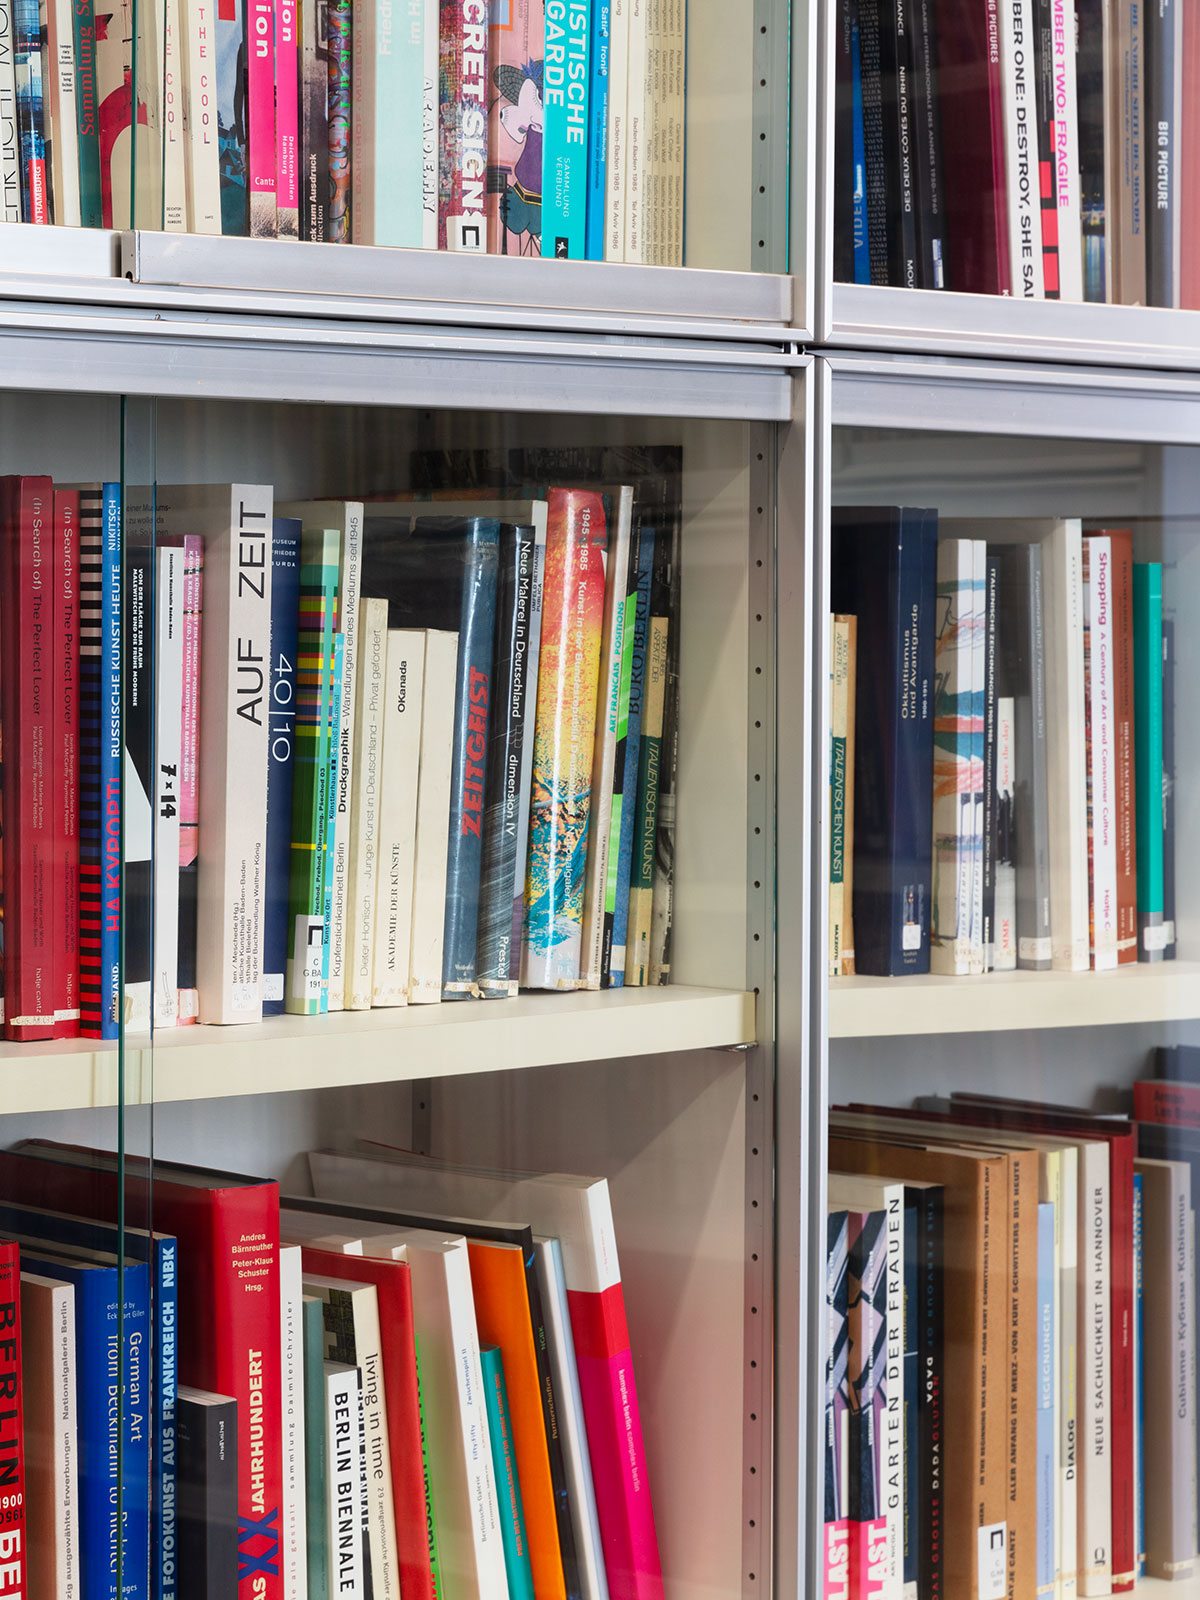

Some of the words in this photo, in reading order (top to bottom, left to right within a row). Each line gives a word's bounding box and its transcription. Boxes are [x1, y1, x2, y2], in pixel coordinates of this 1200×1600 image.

[988, 14, 999, 64] PICTURES
[78, 27, 97, 135] Sammlung
[899, 66, 907, 94] RHIN
[1014, 51, 1026, 101] ONE:
[1056, 61, 1068, 116] TWO:
[282, 135, 291, 175] Hamburg
[614, 116, 623, 170] Baden-Baden
[632, 116, 641, 170] Baden-Baden
[1015, 107, 1030, 208] DESTROY,
[1157, 121, 1170, 147] BIG
[34, 165, 44, 204] HAMBURG
[290, 135, 299, 201] Deichtorhallen
[308, 153, 318, 203] Ausdruck
[555, 156, 563, 207] VERBUND
[562, 157, 571, 218] SAMMLUNG
[614, 172, 622, 191] 1985
[632, 172, 640, 191] 1985
[903, 156, 911, 188] DEUX
[1058, 121, 1070, 208] FRAGILE
[1157, 150, 1170, 210] PICTURE
[630, 231, 638, 249] 1986
[1021, 214, 1033, 259] SHE
[32, 497, 42, 515] (In
[351, 517, 361, 541] 1945
[581, 507, 591, 535] 1945
[32, 518, 42, 567] Search
[63, 528, 73, 577] Search
[238, 500, 267, 599] ZEIT
[519, 540, 532, 575] Neue
[32, 570, 42, 589] of)
[63, 580, 73, 599] of)
[110, 564, 121, 612] HEUTE
[347, 564, 358, 615] Mediums
[517, 577, 529, 622] Malerei
[988, 567, 996, 633] ITALIENISCHE
[1097, 551, 1108, 626] Shopping
[32, 593, 42, 619] The
[63, 603, 73, 629] The
[346, 616, 355, 646] eines
[614, 601, 624, 655] POSITIONS
[32, 623, 42, 673] Perfect
[63, 632, 73, 683] Perfect
[110, 618, 121, 671] KUNST
[909, 604, 919, 688] Avantgarde
[987, 634, 995, 704] ZEICHNUNGEN
[1099, 643, 1107, 686] Century
[32, 676, 42, 716] Lover
[236, 637, 264, 727] AUF
[341, 648, 354, 718] Wandlungen
[397, 660, 408, 713] OKanada
[512, 641, 526, 718] Deutschland
[571, 652, 583, 741] Bundesrepublik
[901, 630, 910, 719] Okkultismus
[63, 687, 73, 725] Lover
[110, 674, 121, 759] RUSSISCHE
[908, 691, 917, 719] und
[338, 728, 350, 813] Druckgraphik
[366, 725, 377, 795] Deutschland
[460, 666, 490, 840] ZEITGEIST
[1101, 748, 1109, 803] Consumer
[507, 754, 519, 819] dimension
[644, 741, 660, 836] ITALIENISCHEN
[1102, 806, 1110, 846] Culture
[338, 842, 347, 873] Berlin
[390, 842, 400, 885] KÜNSTE
[642, 838, 656, 882] KUNST
[389, 888, 398, 911] DER
[252, 898, 260, 955] Buchhandlung
[333, 875, 346, 977] Kupferstichkabinett
[388, 913, 397, 972] AKADEMIE
[498, 935, 509, 979] Prestel
[1012, 1161, 1022, 1196] HEUTE
[888, 1198, 901, 1297] FRAUEN
[1094, 1186, 1104, 1273] HANNOVER
[160, 1246, 174, 1288] NBK
[1011, 1222, 1021, 1293] SCHWITTERS
[61, 1336, 71, 1421] Nationalgalerie
[129, 1331, 143, 1405] German
[161, 1301, 176, 1421] FRANKREICH
[364, 1353, 380, 1407] living
[462, 1354, 473, 1406] Zwischenspiel
[888, 1324, 901, 1390] DER
[925, 1356, 934, 1404] DADA
[1042, 1304, 1051, 1410] BEGEGNUNGEN
[1093, 1302, 1104, 1410] SACHLICHKEIT
[544, 1376, 559, 1440] Partnerschaften
[618, 1368, 628, 1405] komplex
[248, 1348, 265, 1514] JAHRHUNDERT
[334, 1391, 352, 1473] BERLIN
[622, 1404, 633, 1431] berlin
[1009, 1418, 1019, 1465] ANFANG
[1094, 1416, 1104, 1456] NEUE
[63, 1431, 73, 1507] Erwerbungen
[161, 1427, 176, 1466] AUS
[371, 1436, 385, 1480] time
[626, 1430, 637, 1466] complex
[887, 1397, 901, 1509] GARTEN
[505, 1454, 519, 1520] NATIONALGALERIE
[631, 1466, 641, 1493] berlin
[1009, 1467, 1018, 1502] ALLER
[161, 1474, 176, 1586] FOTOKUNST
[338, 1481, 355, 1593] BIENNALE
